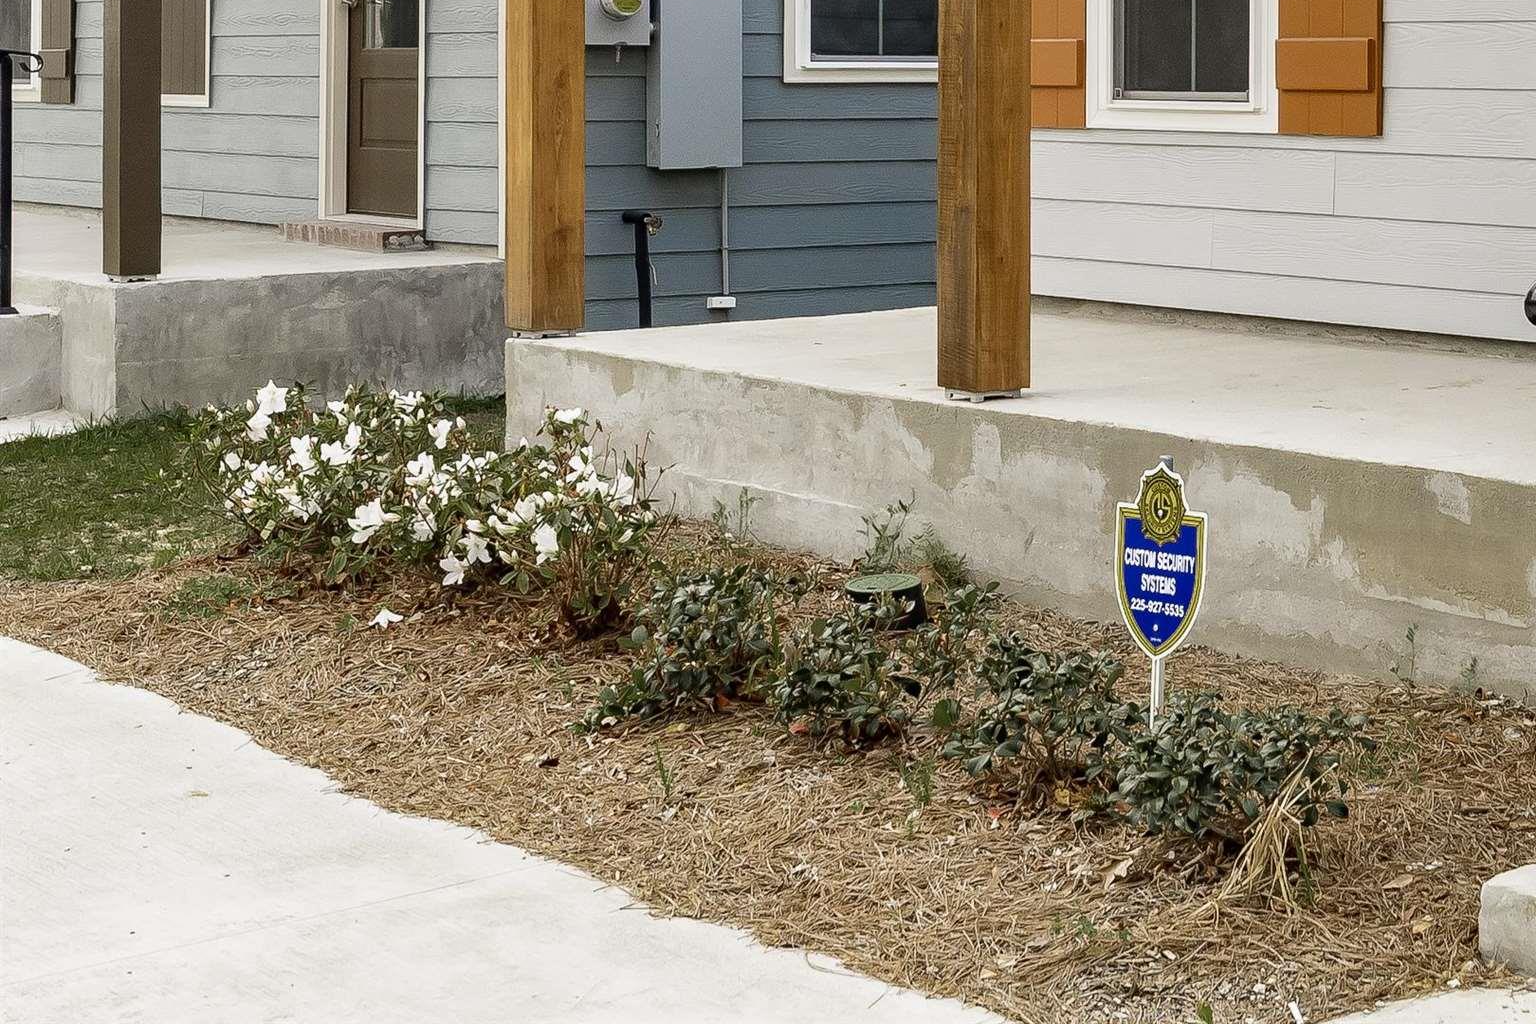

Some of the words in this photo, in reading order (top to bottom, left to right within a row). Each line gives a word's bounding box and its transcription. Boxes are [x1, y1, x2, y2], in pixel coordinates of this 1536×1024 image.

[1124, 547, 1157, 569] CUSTOM
[1157, 551, 1196, 574] SECURITY
[1140, 573, 1177, 596] SYSTEMS
[1130, 597, 1185, 618] 225-927-5535
